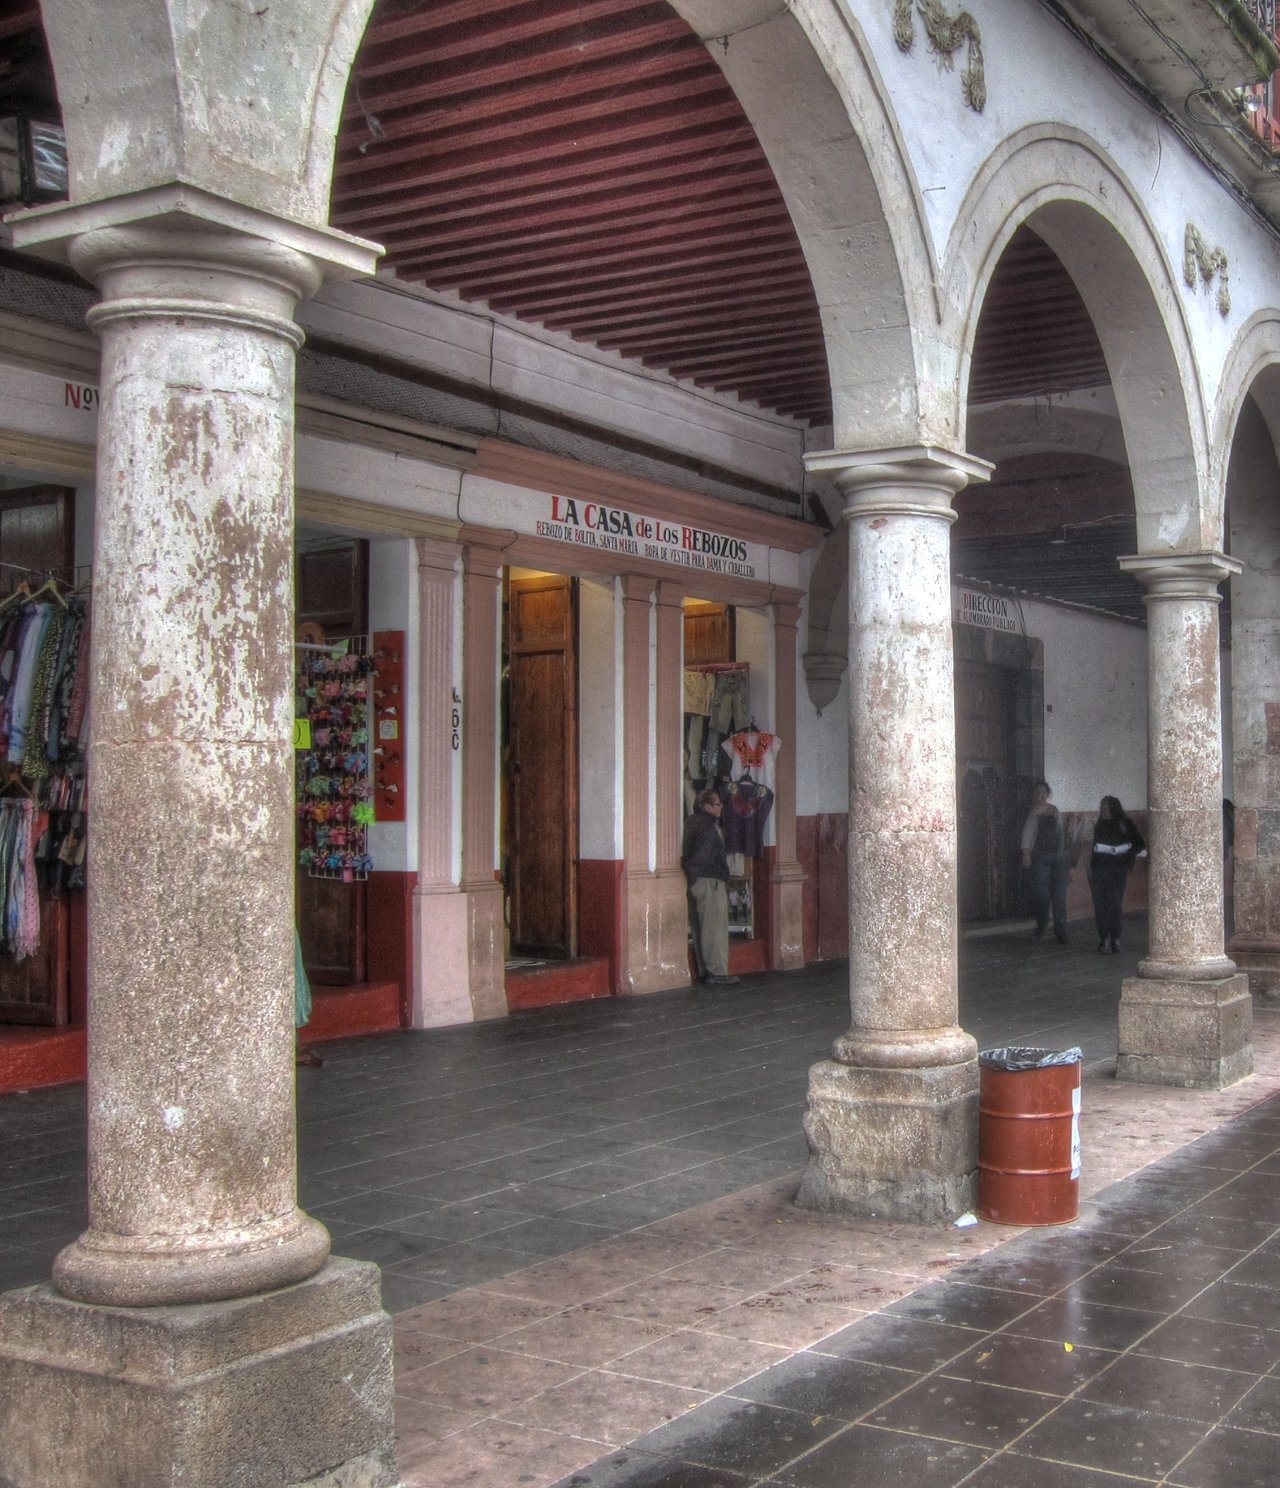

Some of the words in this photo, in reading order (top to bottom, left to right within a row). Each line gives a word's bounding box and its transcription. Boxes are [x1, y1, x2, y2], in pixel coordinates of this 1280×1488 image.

[536, 521, 563, 539] REBOZO
[564, 526, 573, 542] DE
[600, 534, 618, 550] SANTA
[661, 546, 668, 561] DE
[670, 549, 690, 566] VESTIR
[691, 553, 705, 568] PARA
[707, 556, 722, 571] DAMA
[722, 560, 727, 573] Y
[729, 562, 756, 578] CABALLERO
[552, 496, 579, 525] LA
[584, 503, 633, 537] CASA
[636, 518, 652, 539] de
[682, 527, 747, 561] REBOZOS
